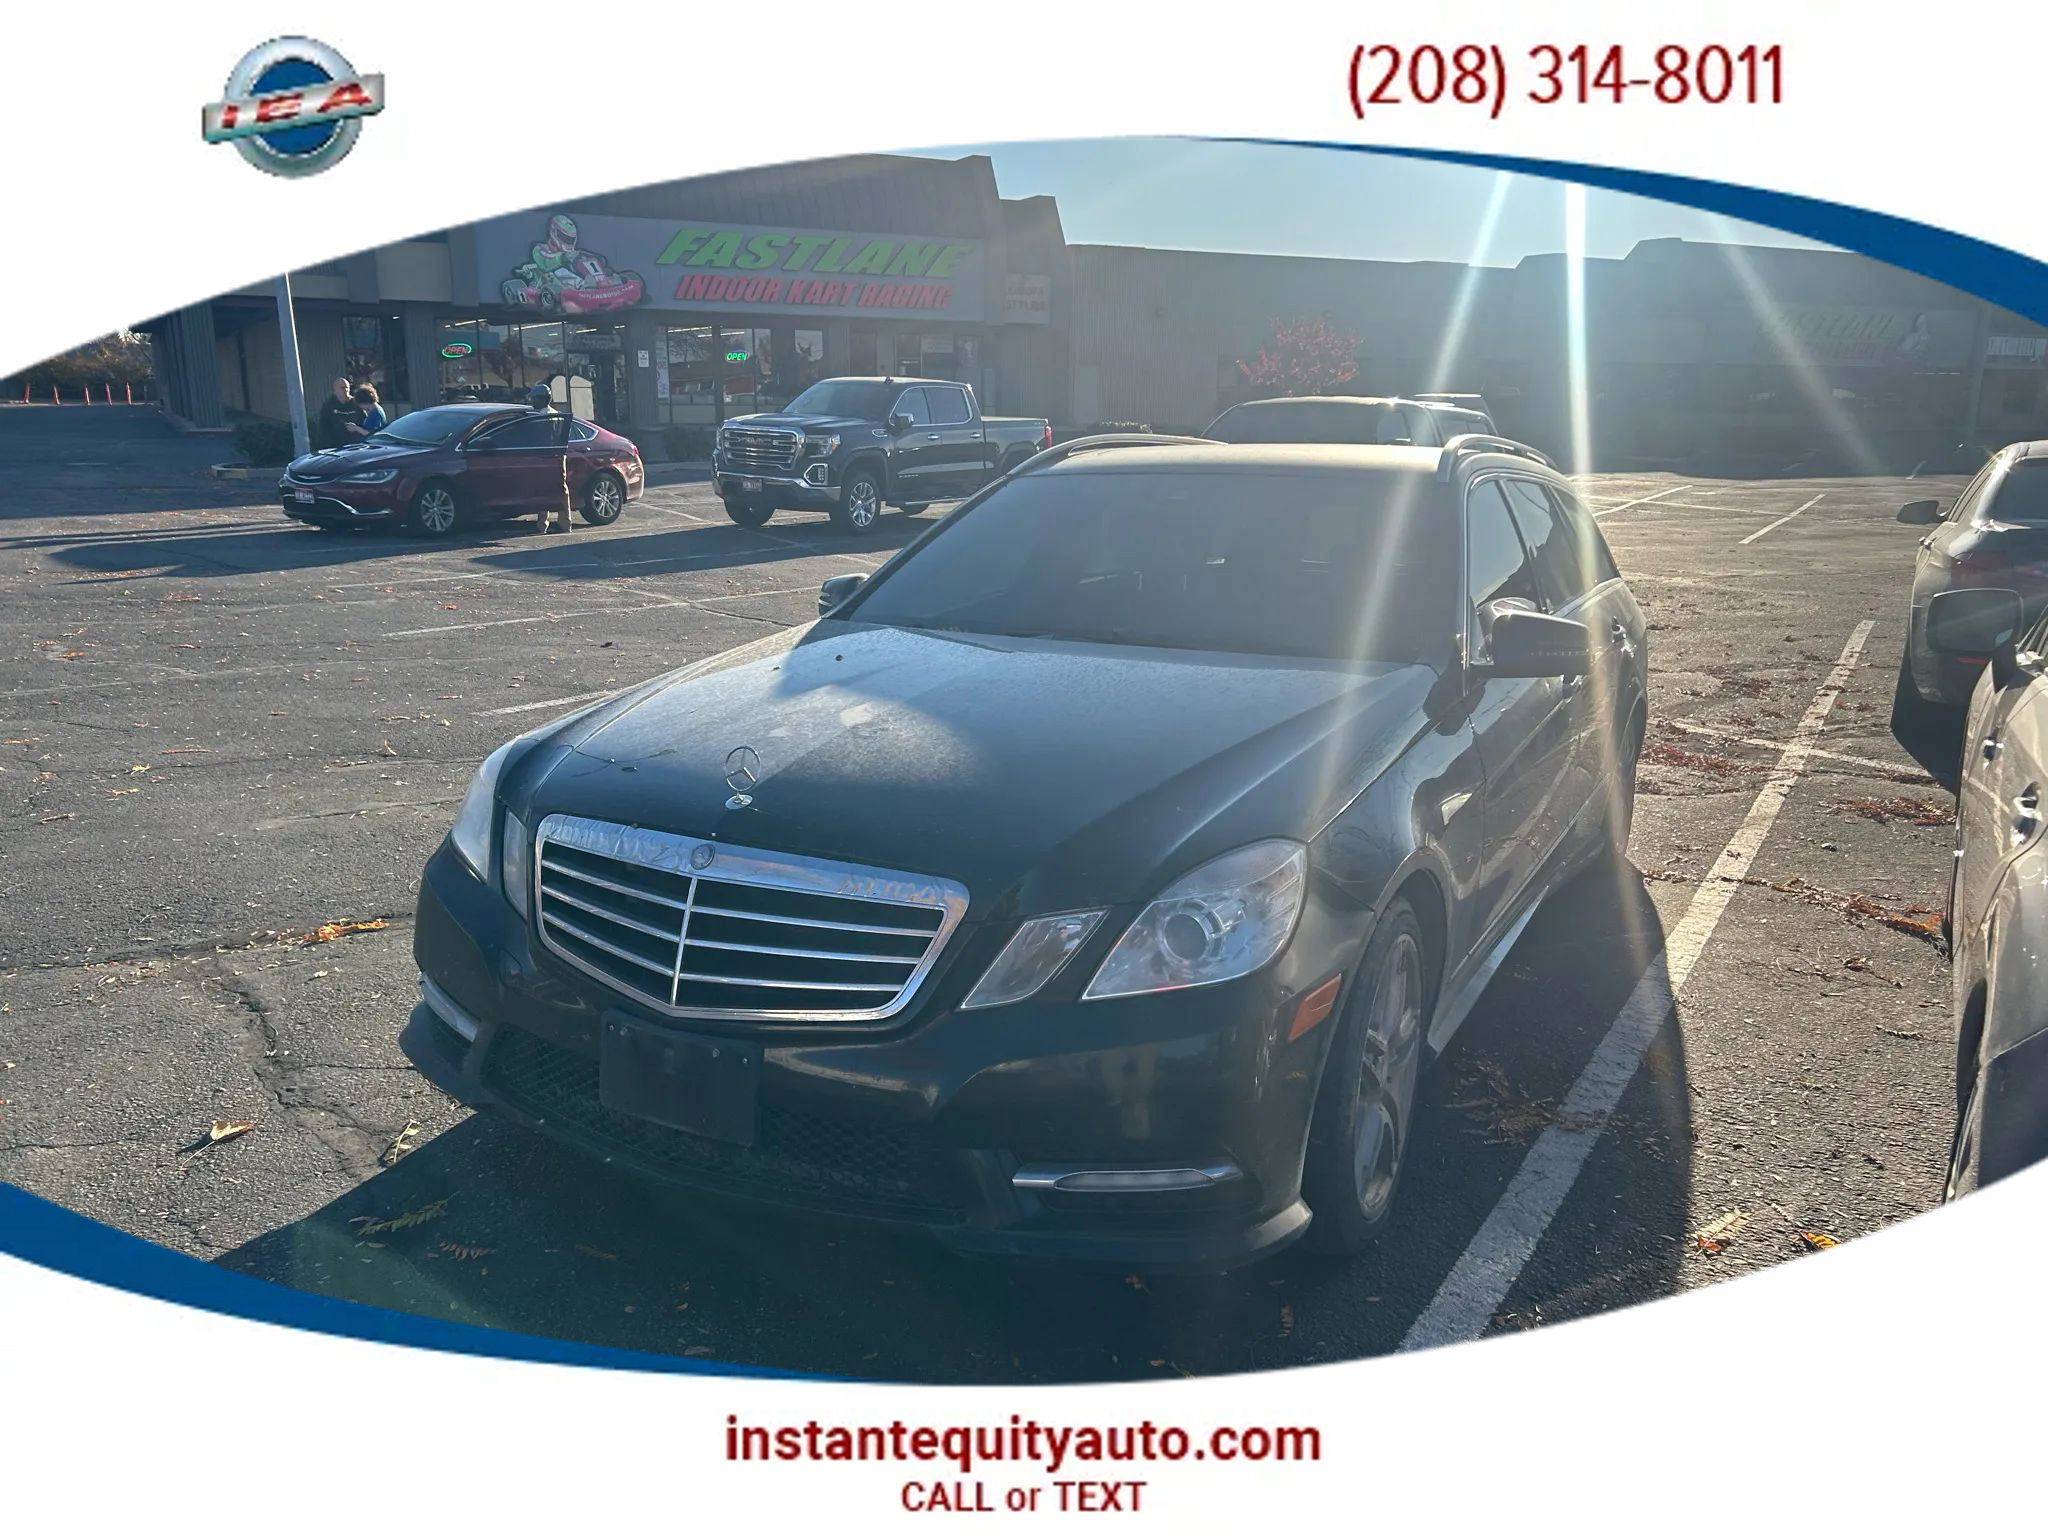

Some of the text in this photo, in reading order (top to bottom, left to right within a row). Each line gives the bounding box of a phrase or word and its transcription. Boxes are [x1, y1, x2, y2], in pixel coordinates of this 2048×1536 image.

[656, 229, 972, 277] FASTLANE
[674, 275, 954, 309] INDOOR KART RACING
[445, 346, 468, 355] OPEN
[726, 352, 747, 361] OPEN
